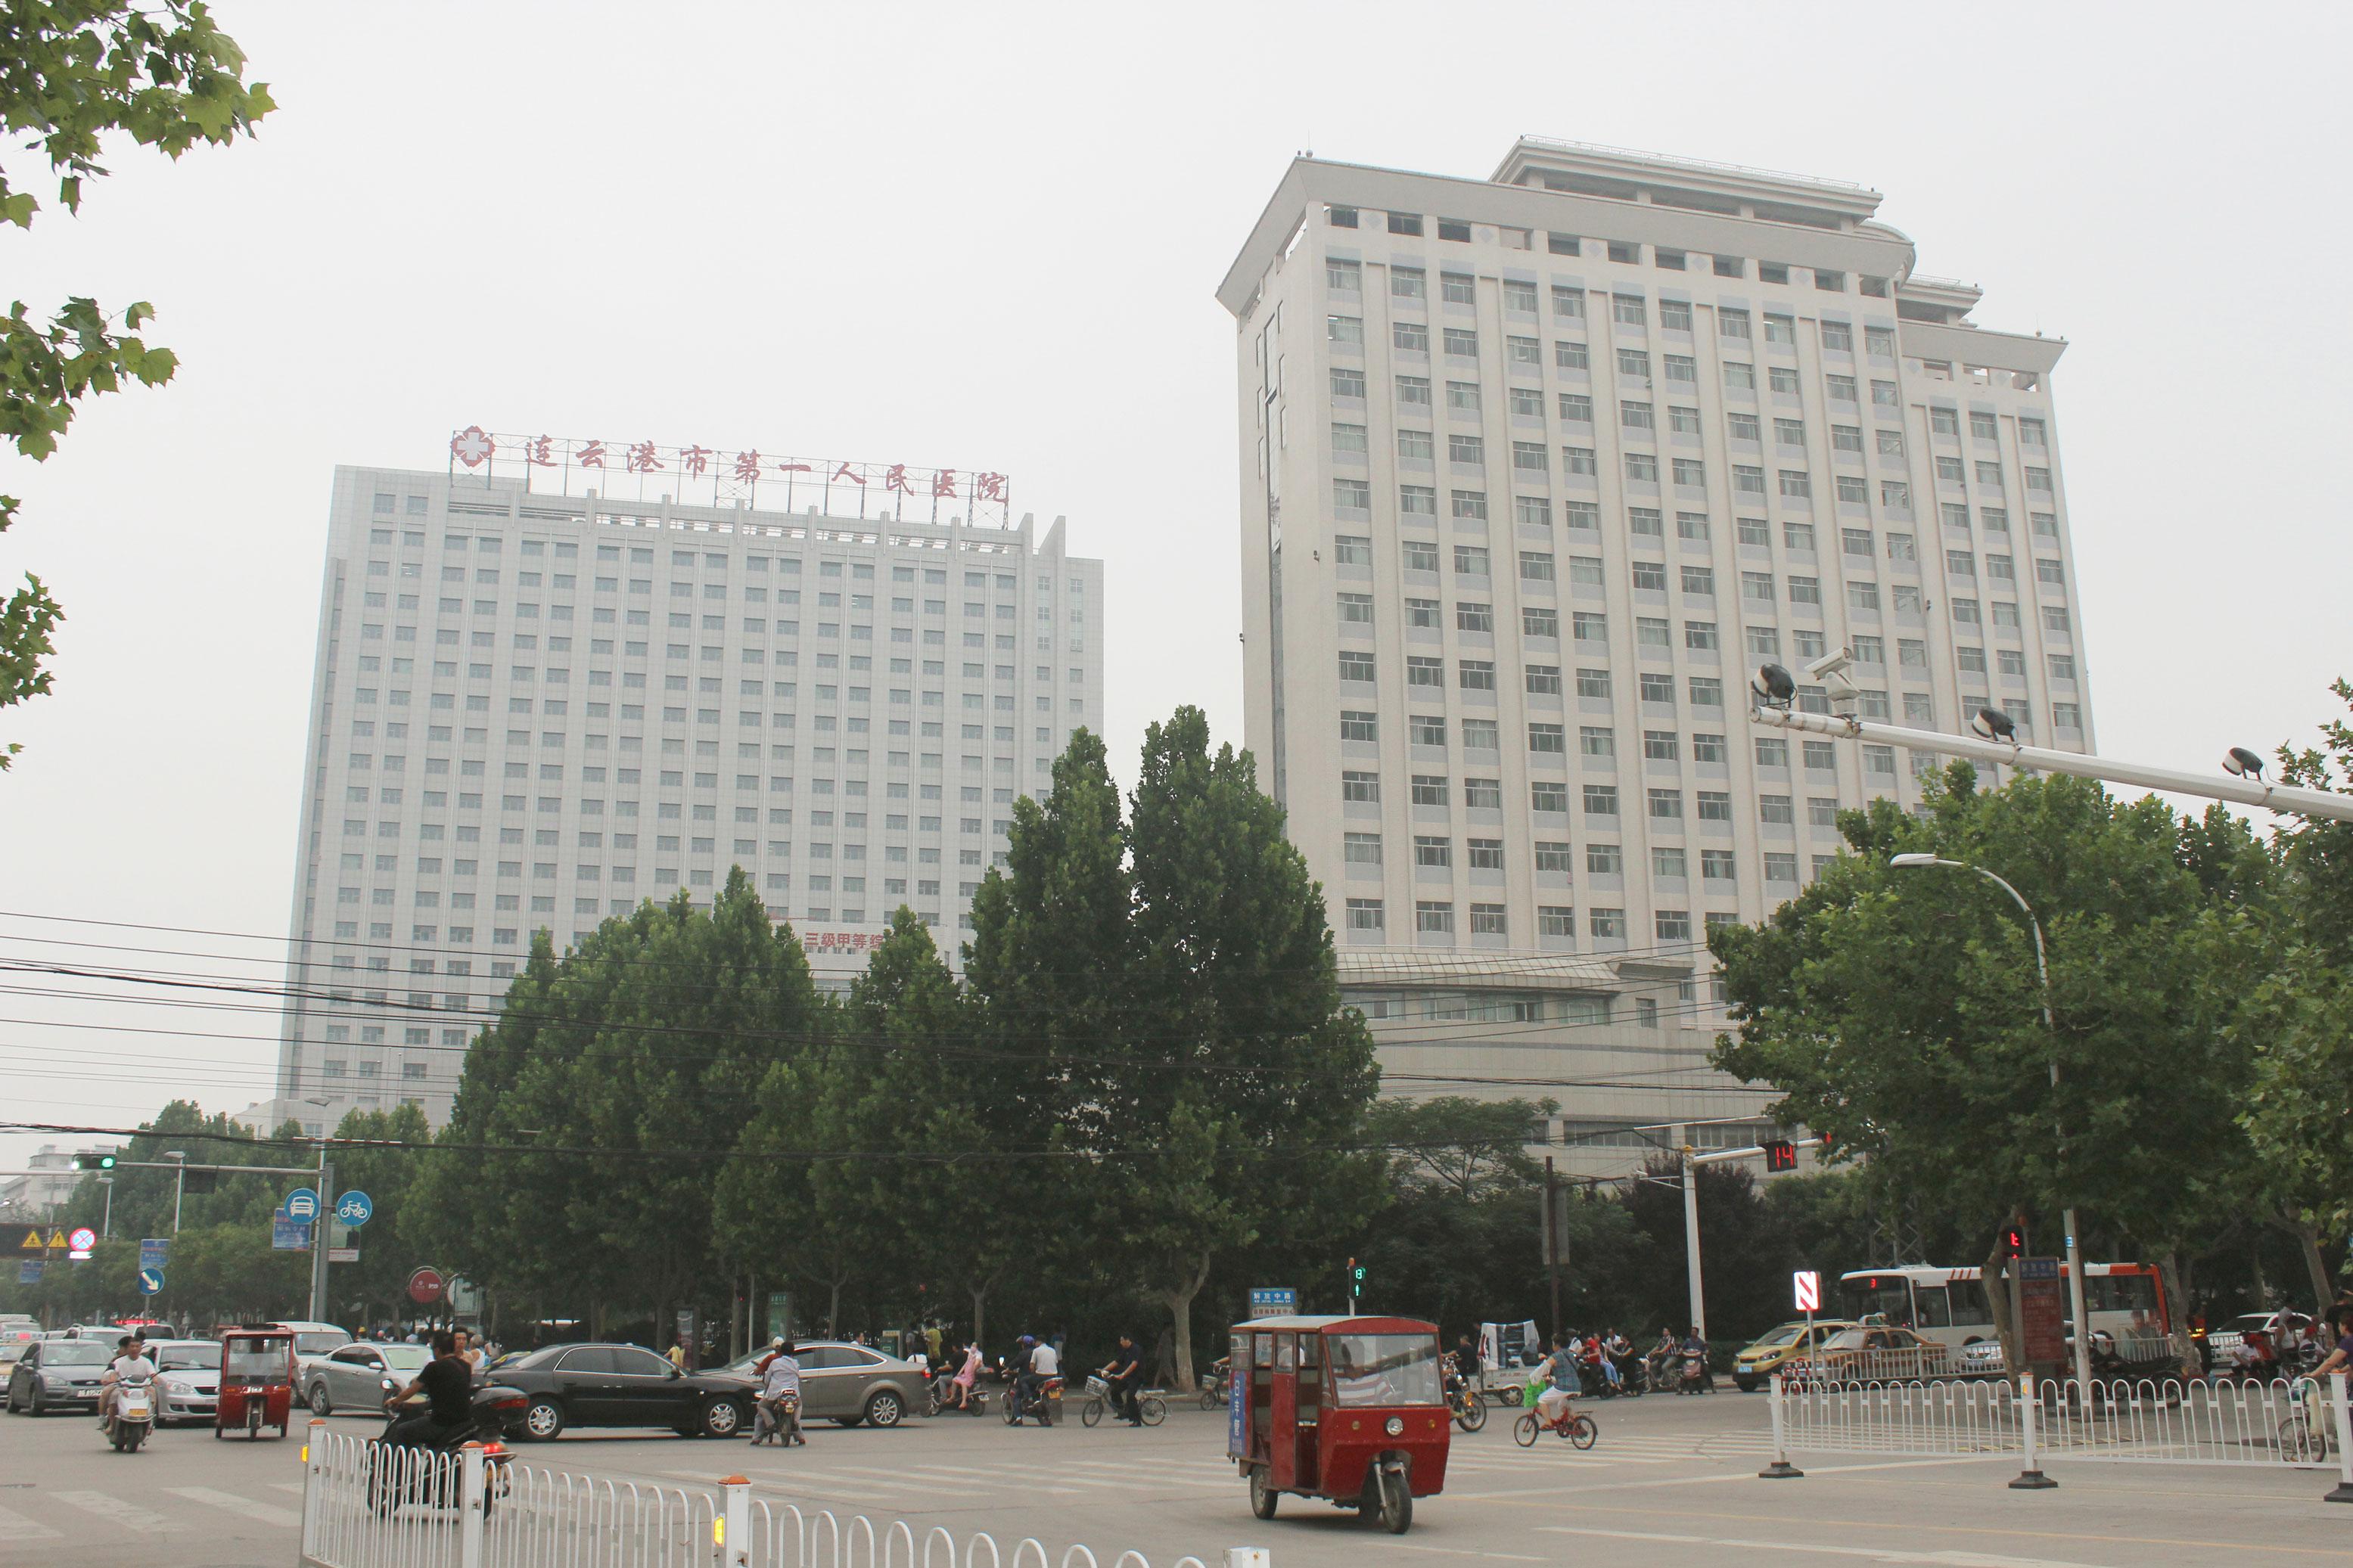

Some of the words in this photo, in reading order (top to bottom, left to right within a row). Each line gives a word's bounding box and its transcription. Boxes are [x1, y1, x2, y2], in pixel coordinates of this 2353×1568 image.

[526, 433, 1009, 503] 连云港市第一人民医院
[1775, 1145, 1795, 1169] 14
[1870, 1278, 1877, 1289] 3
